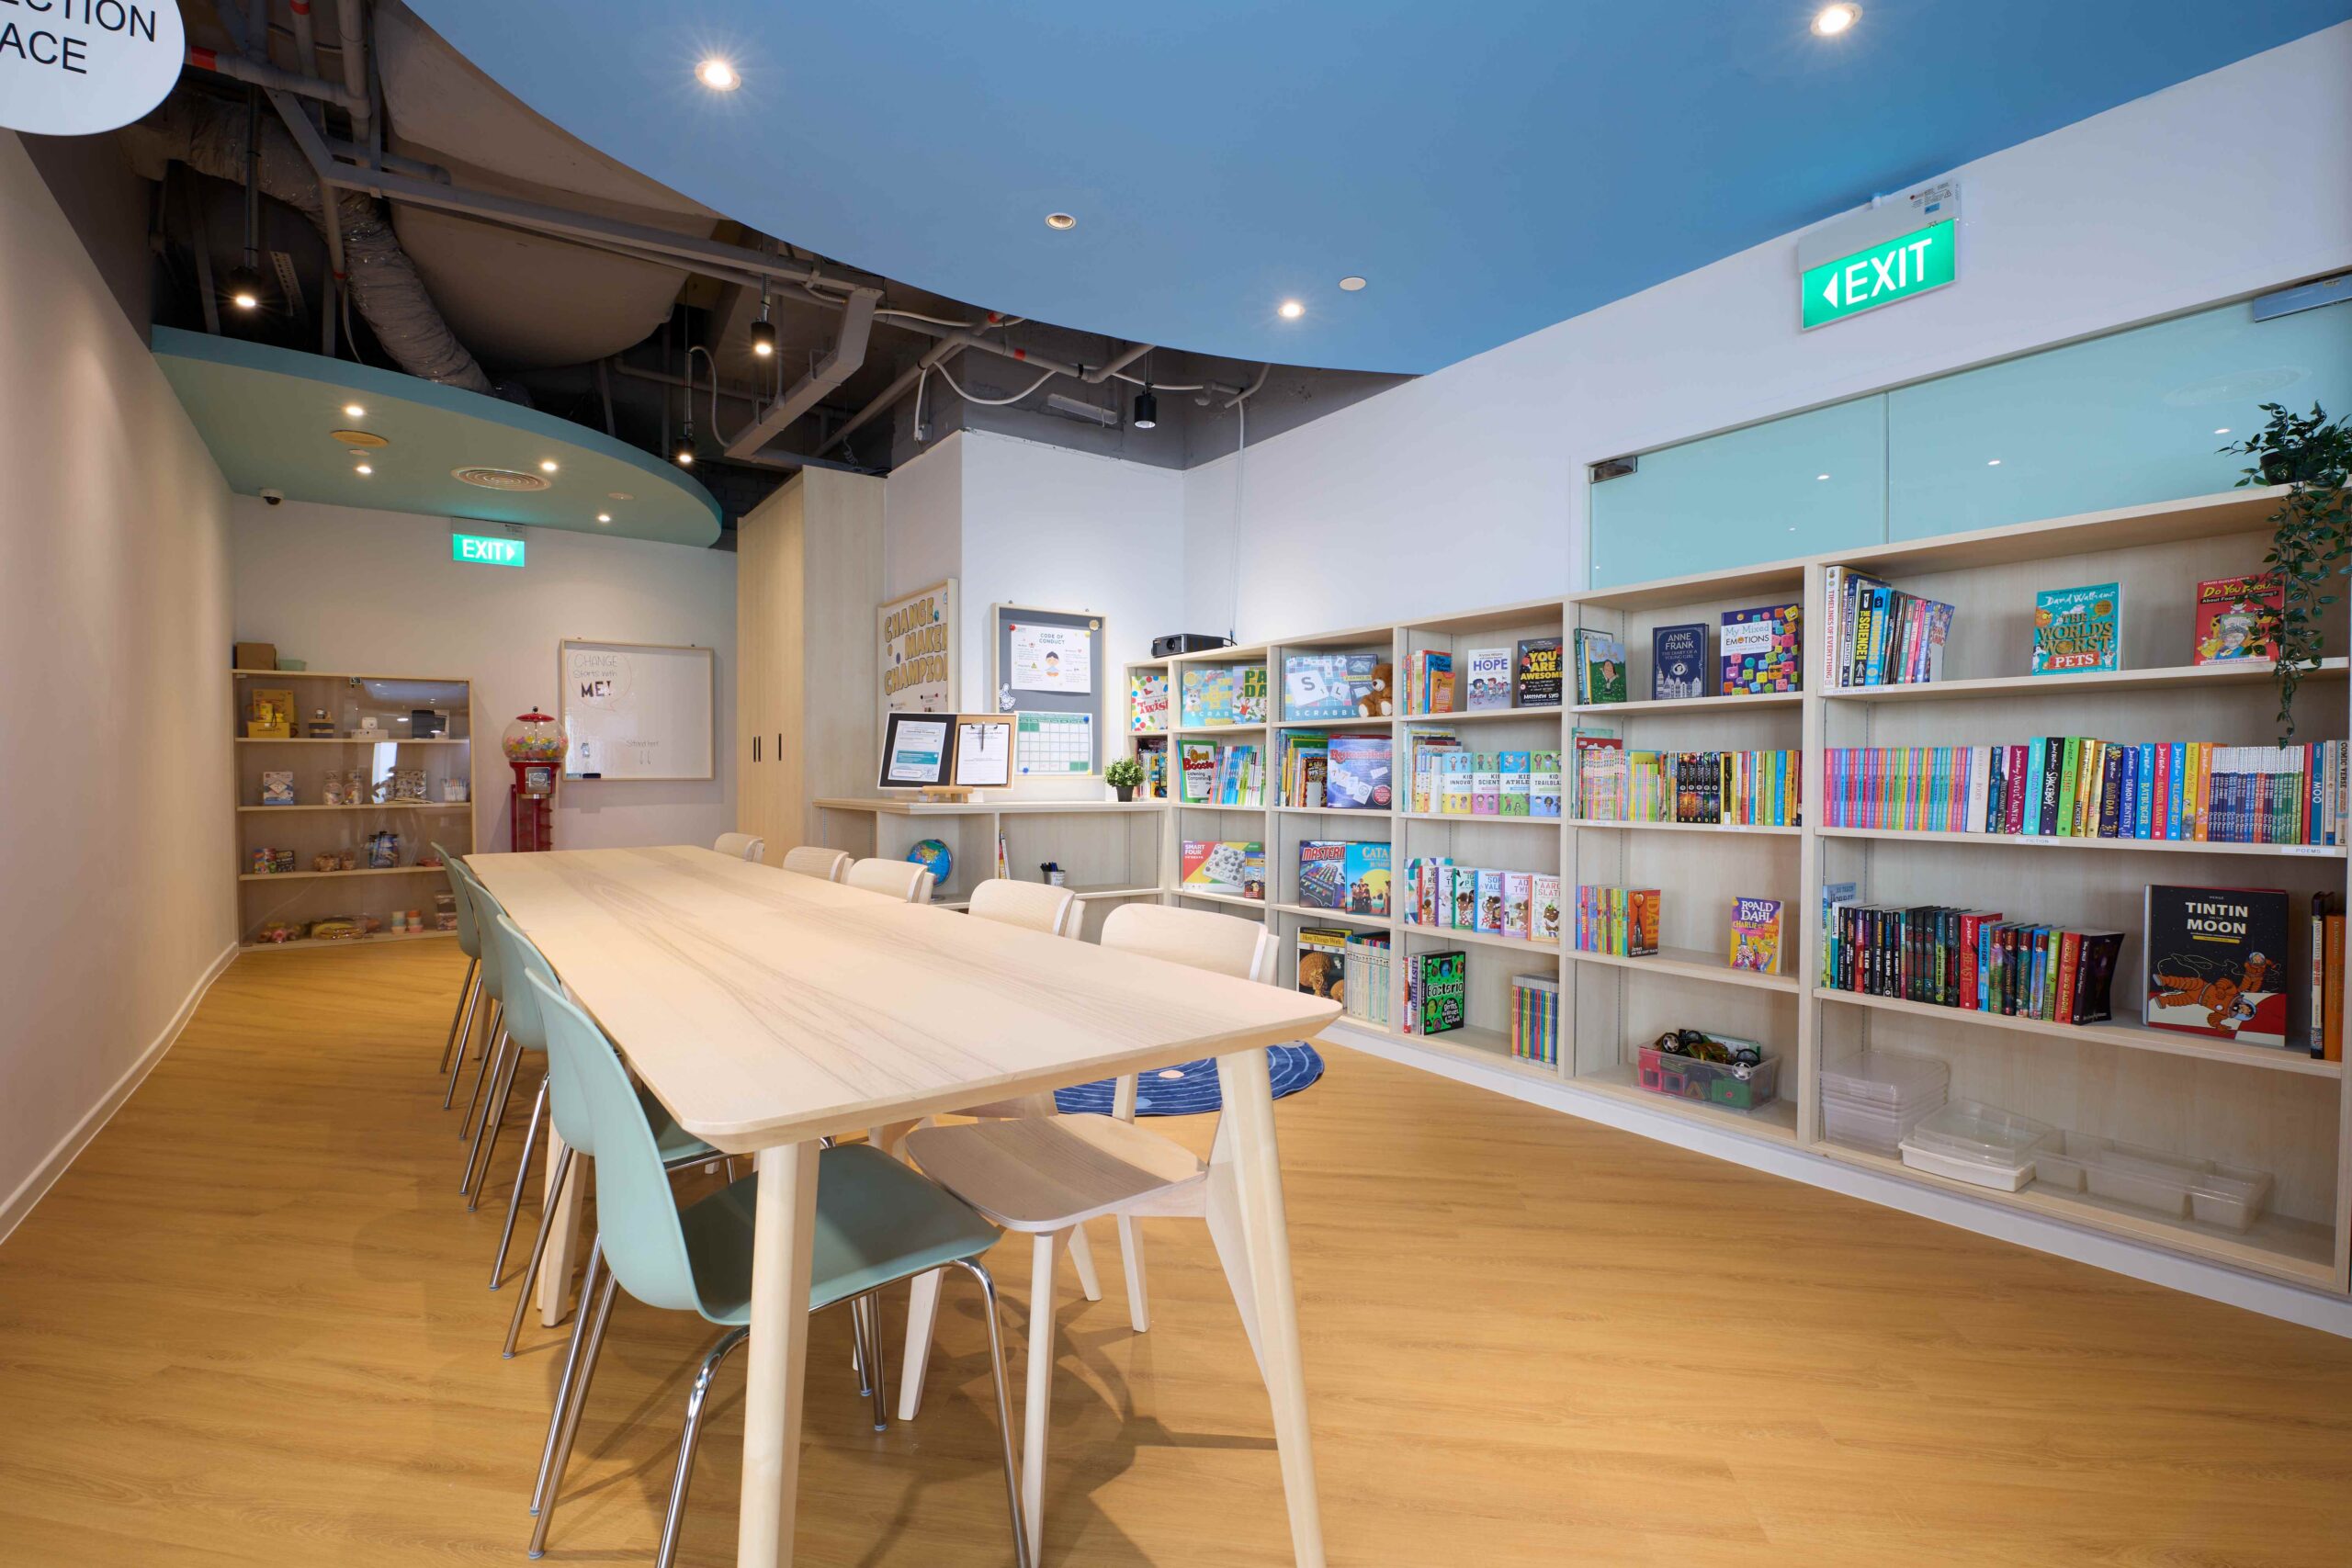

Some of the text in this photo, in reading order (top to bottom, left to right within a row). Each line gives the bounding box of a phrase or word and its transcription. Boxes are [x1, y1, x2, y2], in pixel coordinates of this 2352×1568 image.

[0, 0, 156, 43] TION
[1846, 238, 1932, 306] EXIT
[462, 538, 504, 560] EXIT
[884, 597, 934, 644] CHANGE
[2062, 613, 2087, 625] THE
[1668, 632, 1691, 642] ANNE
[1725, 623, 1770, 637] My Mixed
[1826, 590, 1835, 679] TIMELINES OF EVERYTHING
[1856, 617, 1871, 654] SCIENCE
[2038, 621, 2114, 641] WORLD'S
[1665, 640, 1694, 651] FRANK
[1725, 634, 1770, 646] EMOTIONS
[2041, 634, 2111, 655] WORST
[574, 653, 618, 669] CHANGE
[1473, 659, 1509, 671] HOPE
[1529, 650, 1557, 663] YOU
[2055, 653, 2094, 668] PETS
[1530, 661, 1556, 672] ARE
[581, 681, 612, 698] ME!
[1437, 678, 1442, 690] 7
[1190, 749, 1210, 762] Oral
[2339, 742, 2348, 789] COMIC VERSE
[2043, 771, 2058, 807] SPACEBOY
[2062, 771, 2073, 793] SLIME
[2124, 778, 2133, 801] DEMON
[2312, 781, 2322, 804] MOO
[2140, 783, 2150, 825] RATBURGER
[2123, 802, 2132, 829] DENTIST
[1741, 900, 1774, 912] ROALD
[2185, 901, 2249, 918] TINTIN
[1733, 919, 1758, 929] CHARLIE
[1740, 909, 1773, 923] DAHL
[2187, 919, 2247, 935] MOON
[1313, 935, 1329, 943] Things
[1962, 952, 1973, 985] BEAST
[1427, 981, 1464, 998] Bacteria
